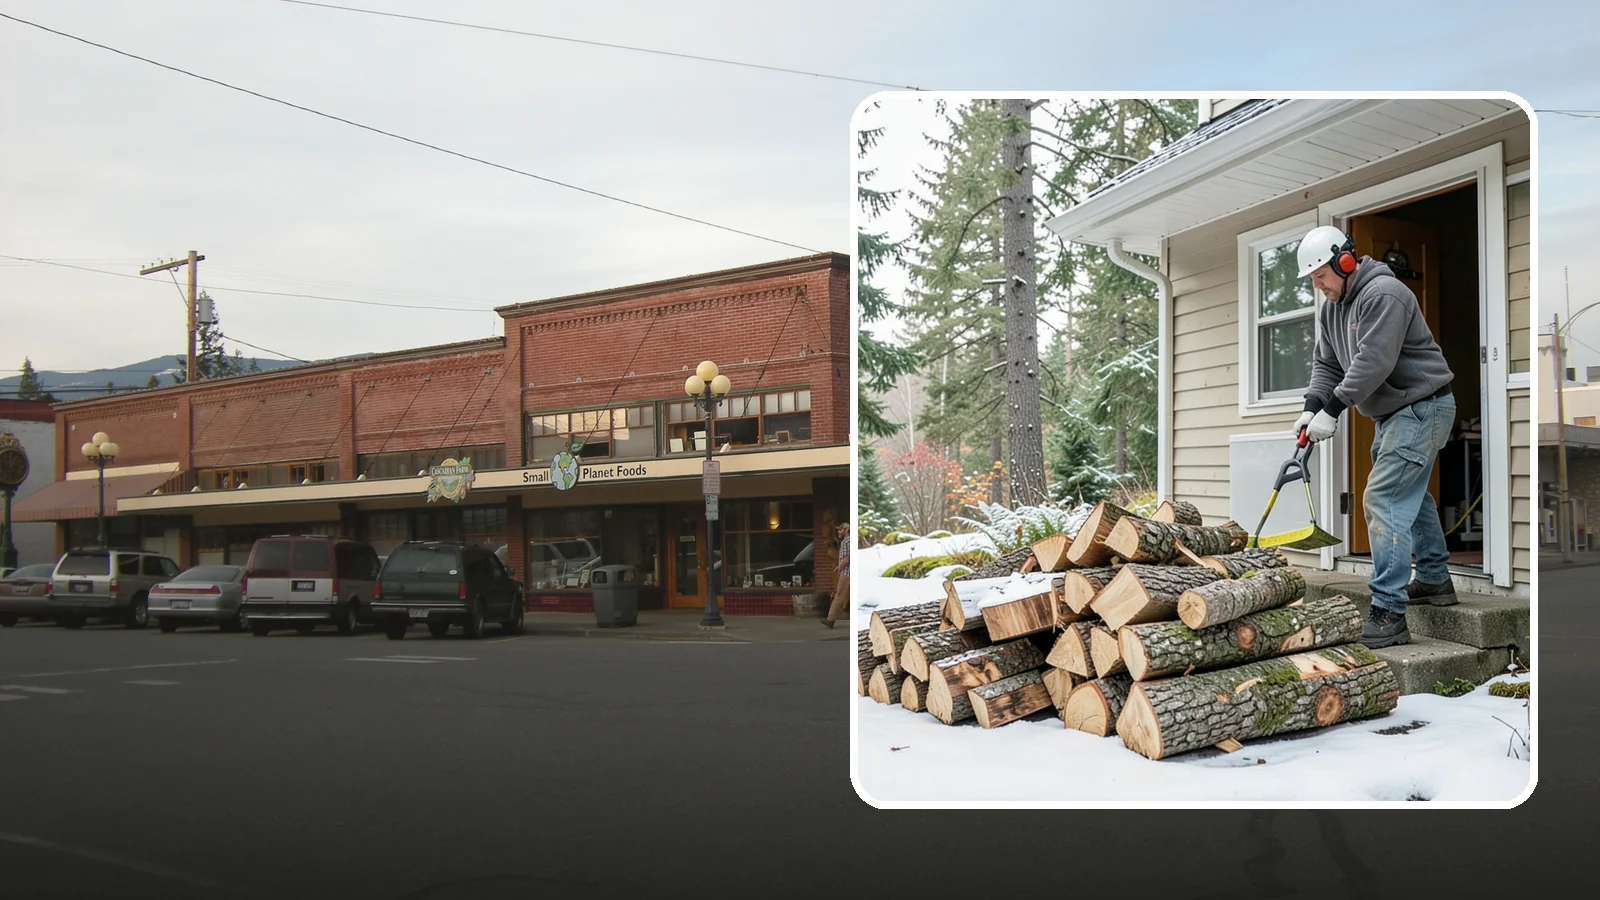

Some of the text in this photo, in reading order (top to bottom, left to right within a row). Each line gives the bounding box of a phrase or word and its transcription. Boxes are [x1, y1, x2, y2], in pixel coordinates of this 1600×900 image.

[522, 464, 647, 483] Small Planet Foods
